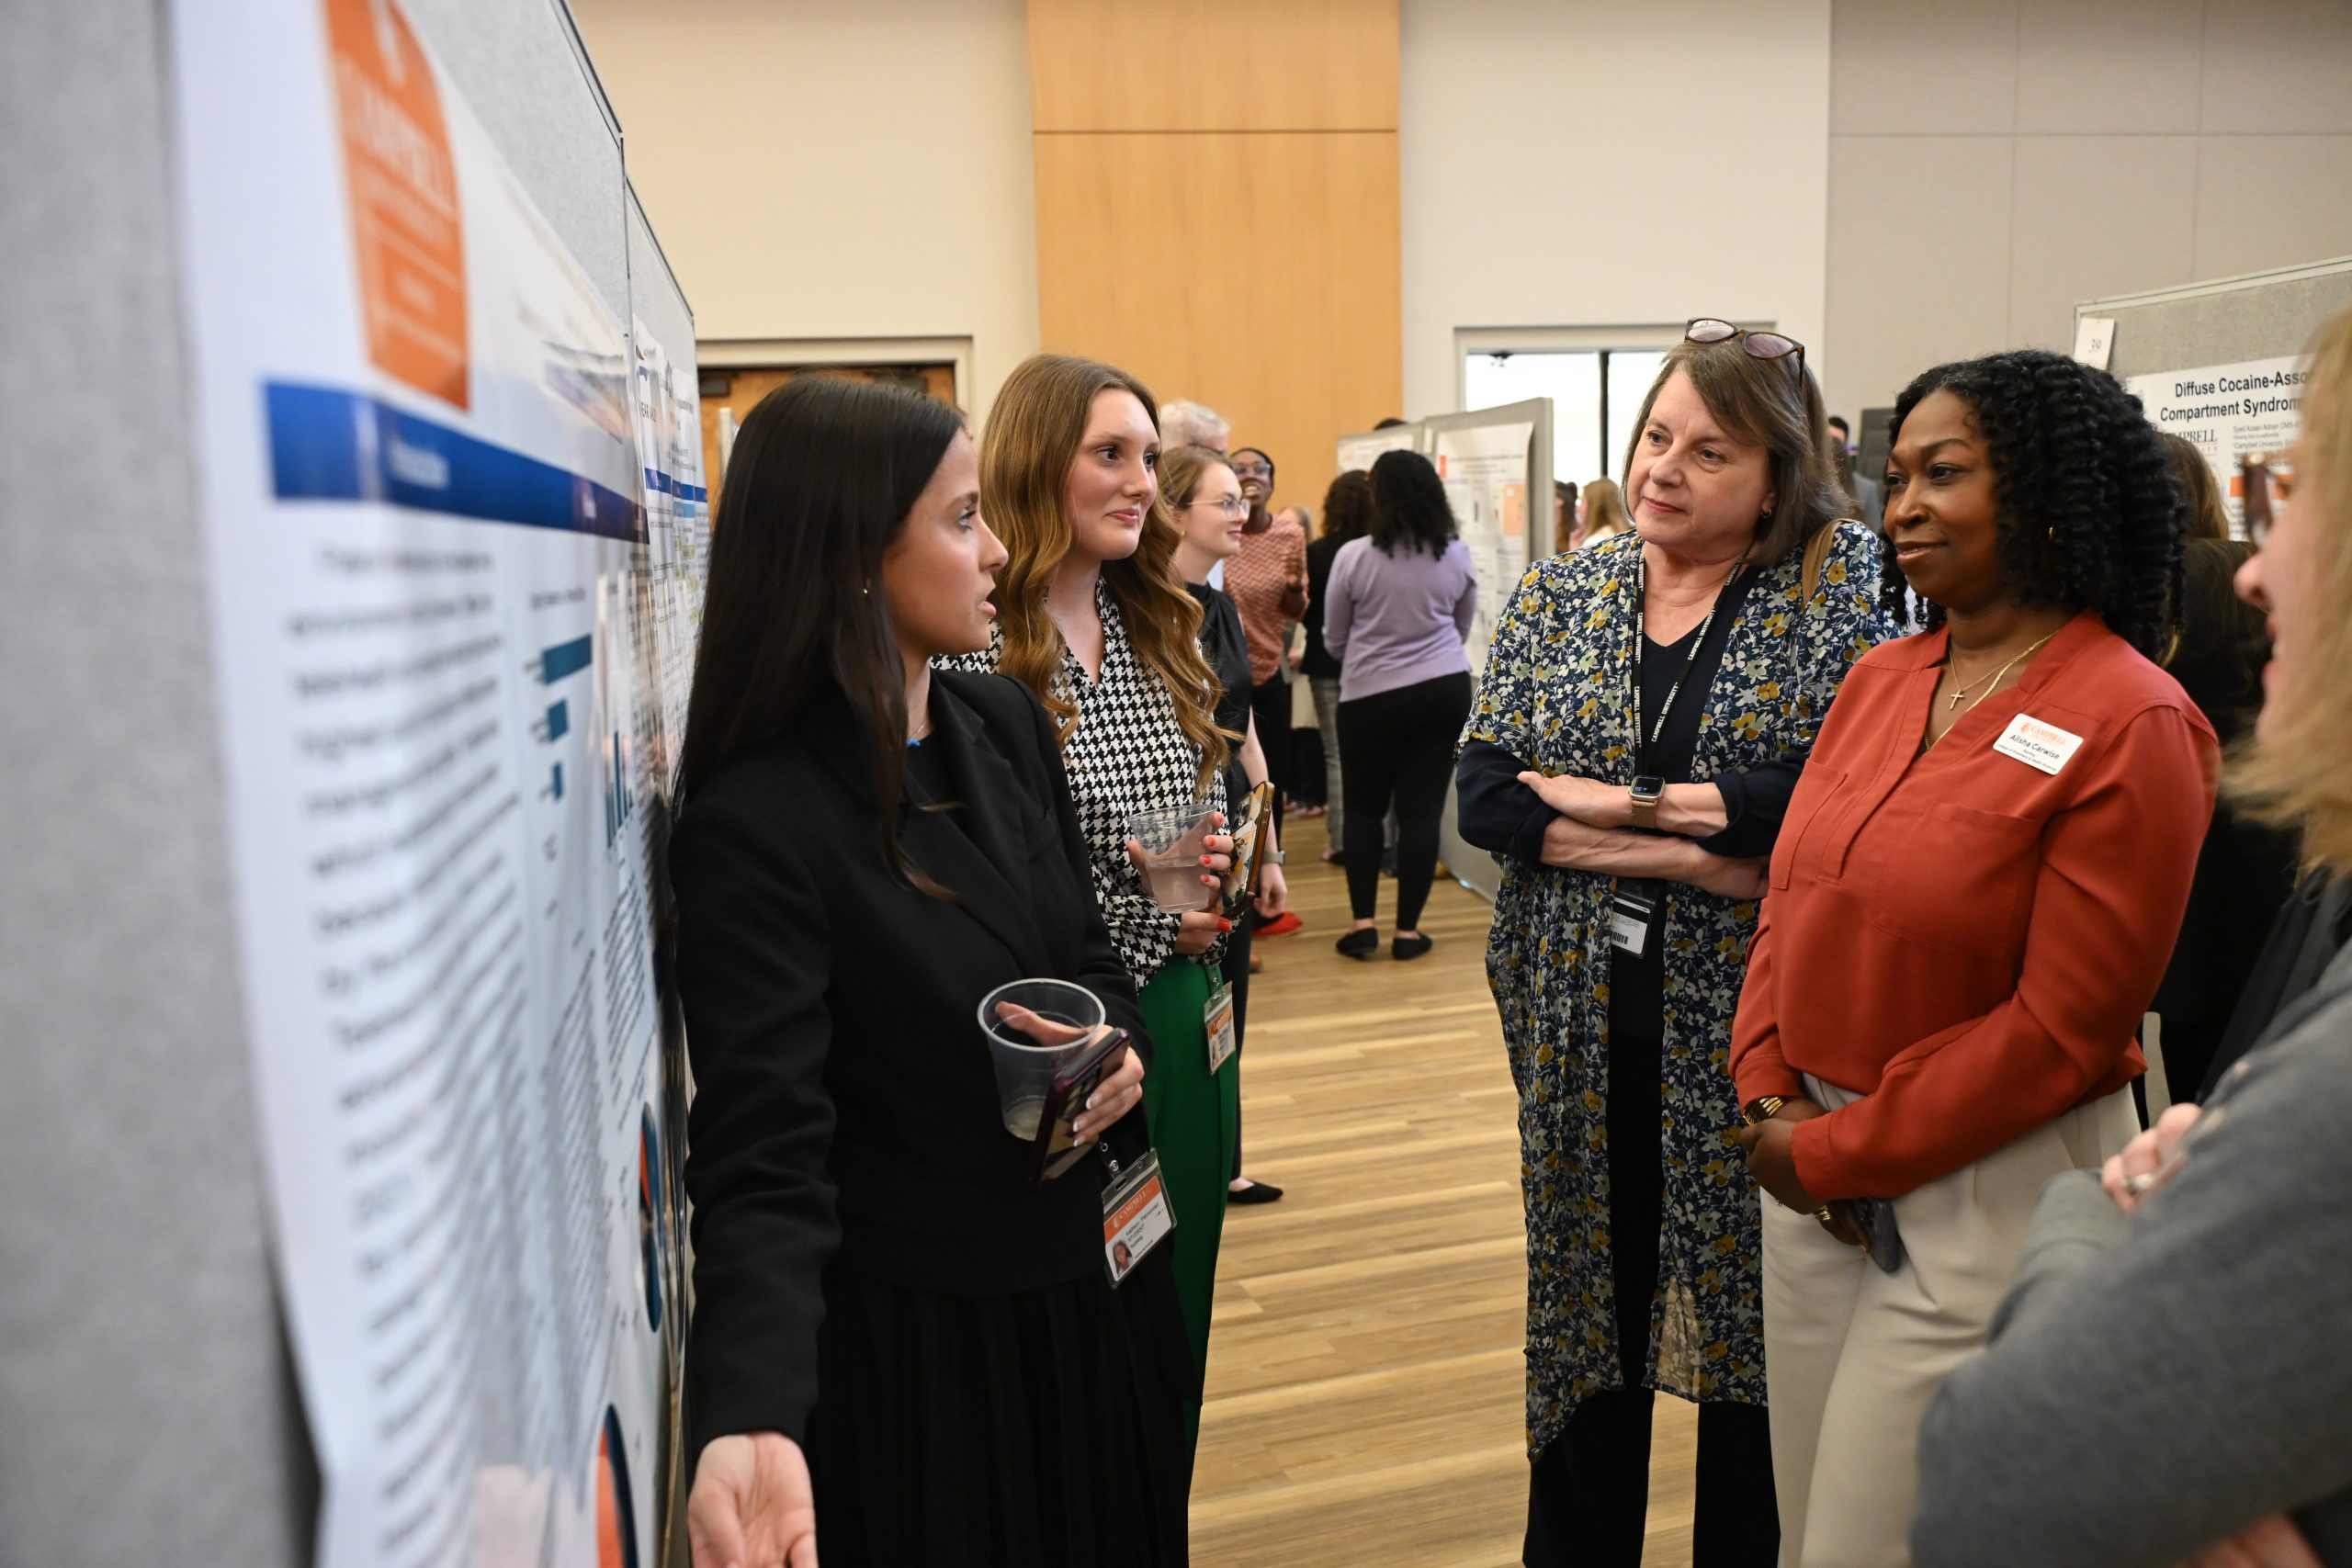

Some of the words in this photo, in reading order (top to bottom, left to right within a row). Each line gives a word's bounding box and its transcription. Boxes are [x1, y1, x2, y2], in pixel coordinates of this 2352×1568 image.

[2175, 380, 2215, 398] Diffuse
[2219, 370, 2308, 393] Cocaine-Asso
[2160, 400, 2240, 423] Compartment
[2243, 396, 2303, 417] Syndrom
[2178, 429, 2218, 443] PBELL
[2031, 742, 2060, 760] Carwise
